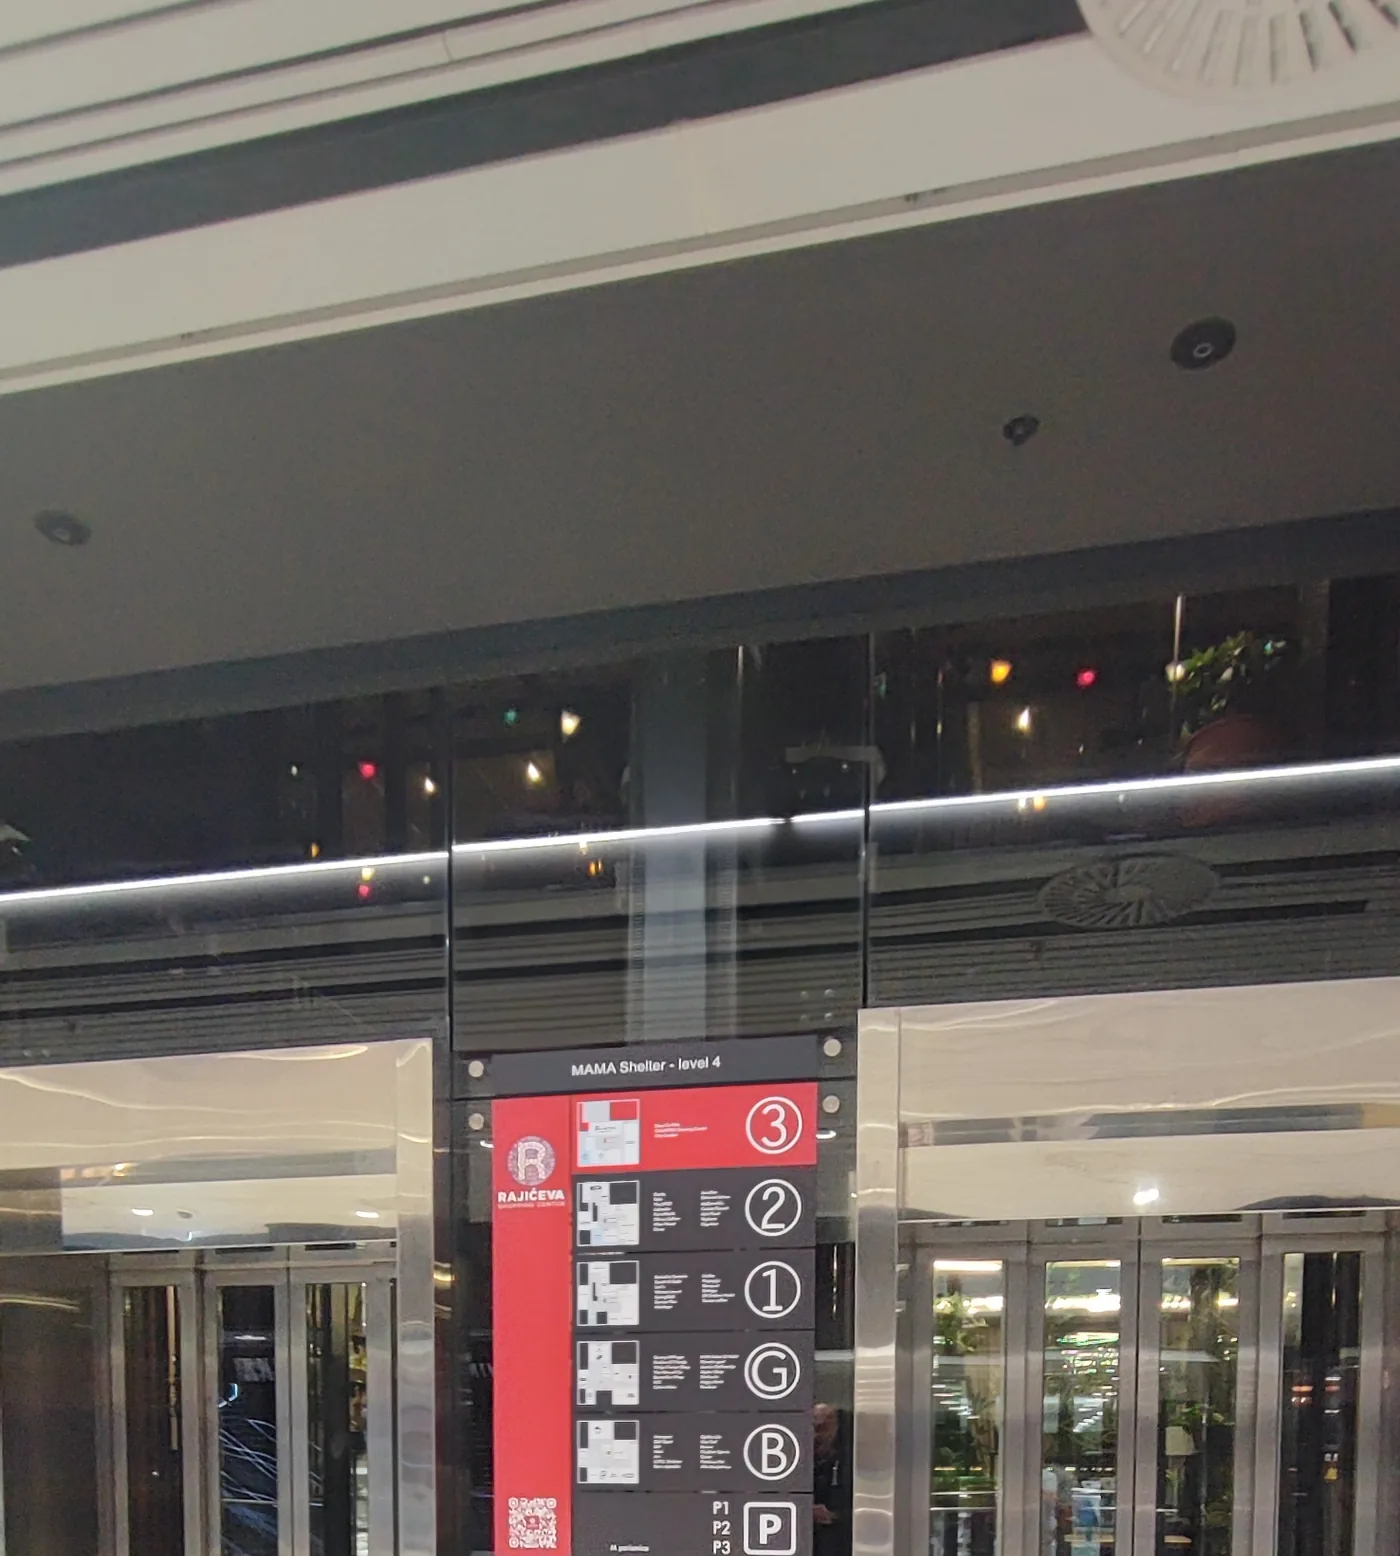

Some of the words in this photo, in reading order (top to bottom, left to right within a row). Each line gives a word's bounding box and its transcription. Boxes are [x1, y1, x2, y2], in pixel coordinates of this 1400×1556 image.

[571, 1061, 617, 1076] MAMA
[619, 1060, 666, 1074] Shelter
[678, 1056, 709, 1070] level
[712, 1055, 721, 1068] 4
[760, 1103, 787, 1148] 3
[497, 1187, 565, 1203] RAJIĆEVA
[760, 1186, 785, 1230] 2
[761, 1268, 784, 1312] 1
[751, 1350, 788, 1392] G
[761, 1432, 788, 1474] B
[712, 1501, 729, 1515] P1
[712, 1520, 731, 1535] P2
[759, 1513, 782, 1545] P
[712, 1540, 731, 1555] P3
